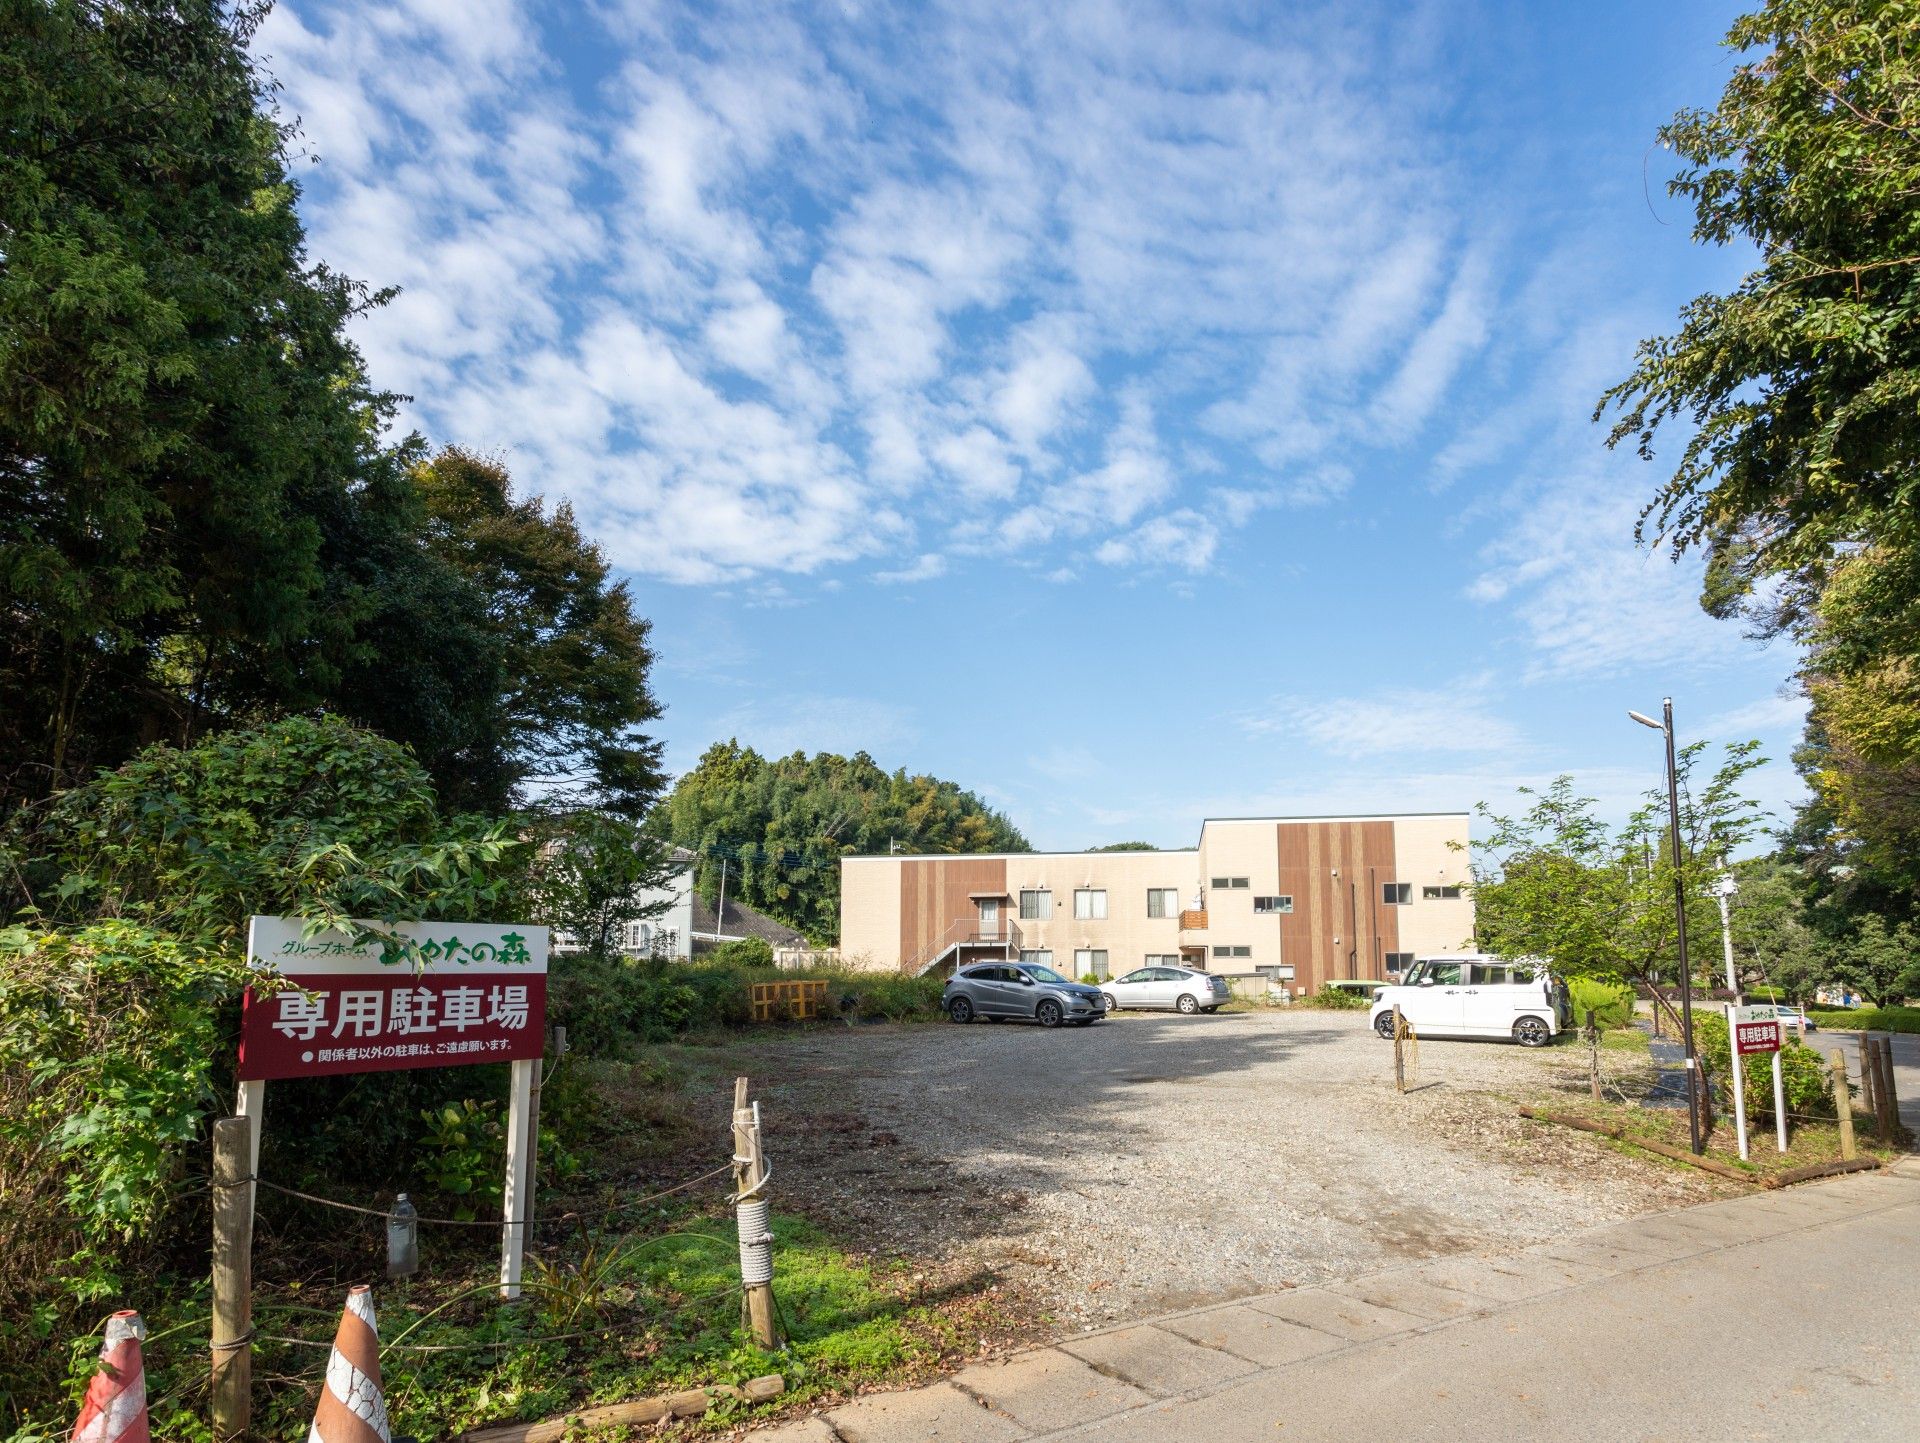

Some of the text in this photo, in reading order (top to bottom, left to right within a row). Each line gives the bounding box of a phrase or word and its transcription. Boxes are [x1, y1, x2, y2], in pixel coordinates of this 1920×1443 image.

[272, 985, 530, 1041] 専用駐車場
[1739, 1026, 1776, 1043] 専用駐車場
